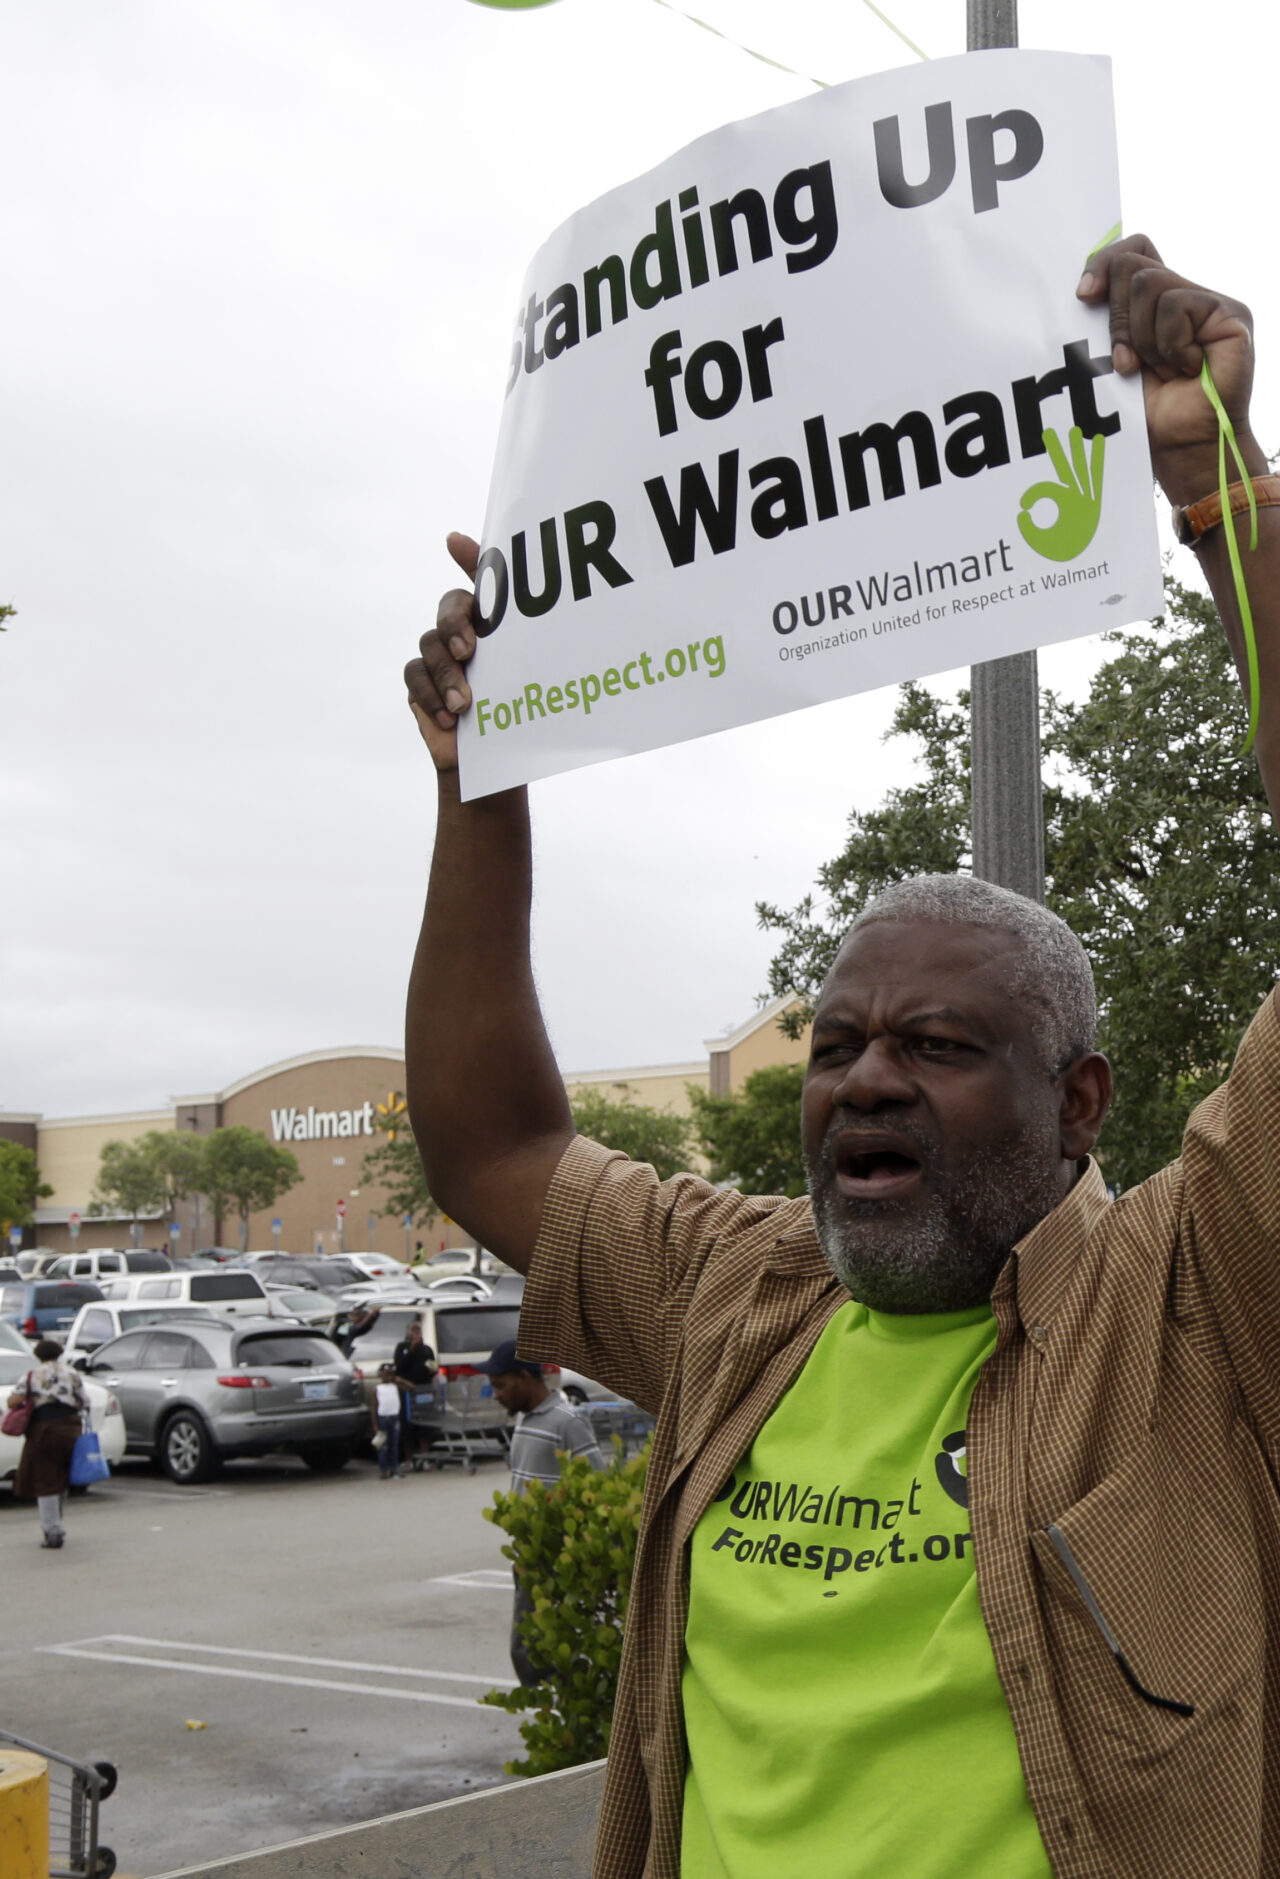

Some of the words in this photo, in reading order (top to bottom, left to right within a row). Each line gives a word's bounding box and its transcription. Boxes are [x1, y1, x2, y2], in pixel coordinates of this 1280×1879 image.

[873, 101, 1044, 214] Up
[644, 316, 785, 438] for
[474, 500, 634, 638] OUR
[643, 338, 1122, 568] Walmart
[779, 627, 868, 662] Organization
[871, 610, 922, 636] United
[926, 604, 947, 622] for
[951, 586, 1015, 614] Respect
[1019, 580, 1036, 597] at
[1041, 560, 1110, 591] Walmart
[475, 634, 726, 737] ForRespect.org
[270, 1101, 374, 1141] Walmart
[711, 1527, 973, 1581] ForRespect.or
